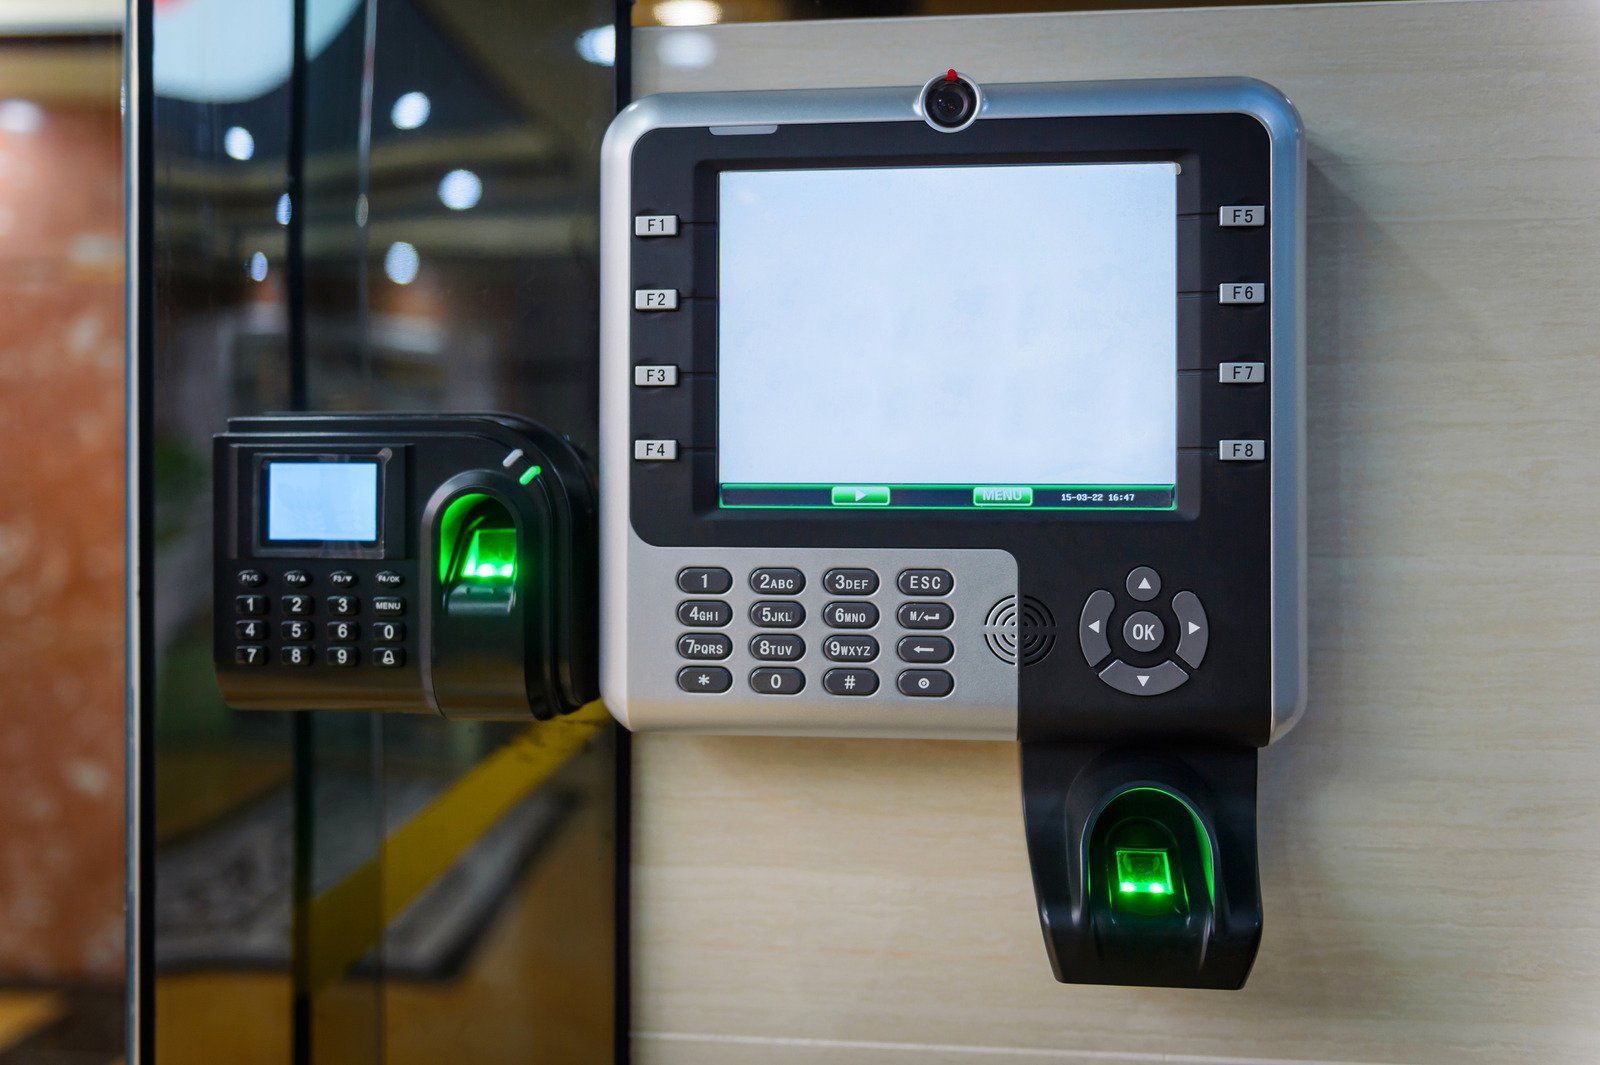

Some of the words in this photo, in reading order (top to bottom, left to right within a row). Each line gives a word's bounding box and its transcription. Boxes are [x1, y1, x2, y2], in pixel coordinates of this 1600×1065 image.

[1232, 210, 1253, 223] F5
[648, 219, 664, 232] F1
[647, 293, 666, 306] F2
[1232, 287, 1253, 300] F6
[647, 369, 666, 382] F3
[1232, 366, 1253, 380] F7
[646, 443, 666, 457] F4
[1232, 443, 1253, 457] F8
[981, 489, 1023, 502] MENU
[1061, 493, 1104, 502] 15-03-22
[1108, 493, 1135, 502] 16:47
[701, 574, 708, 588] 1
[910, 576, 941, 589] ESC
[247, 597, 254, 612] 1
[292, 597, 302, 612] 2
[338, 598, 348, 613] 3
[376, 602, 401, 610] MENU
[245, 622, 255, 637] 4
[291, 623, 301, 638] 5
[337, 624, 348, 639] 6
[384, 624, 394, 639] 0
[1132, 624, 1155, 641] OK
[247, 648, 257, 663] 7
[291, 648, 301, 663] 8
[337, 650, 347, 664] 9
[770, 674, 782, 689] 0
